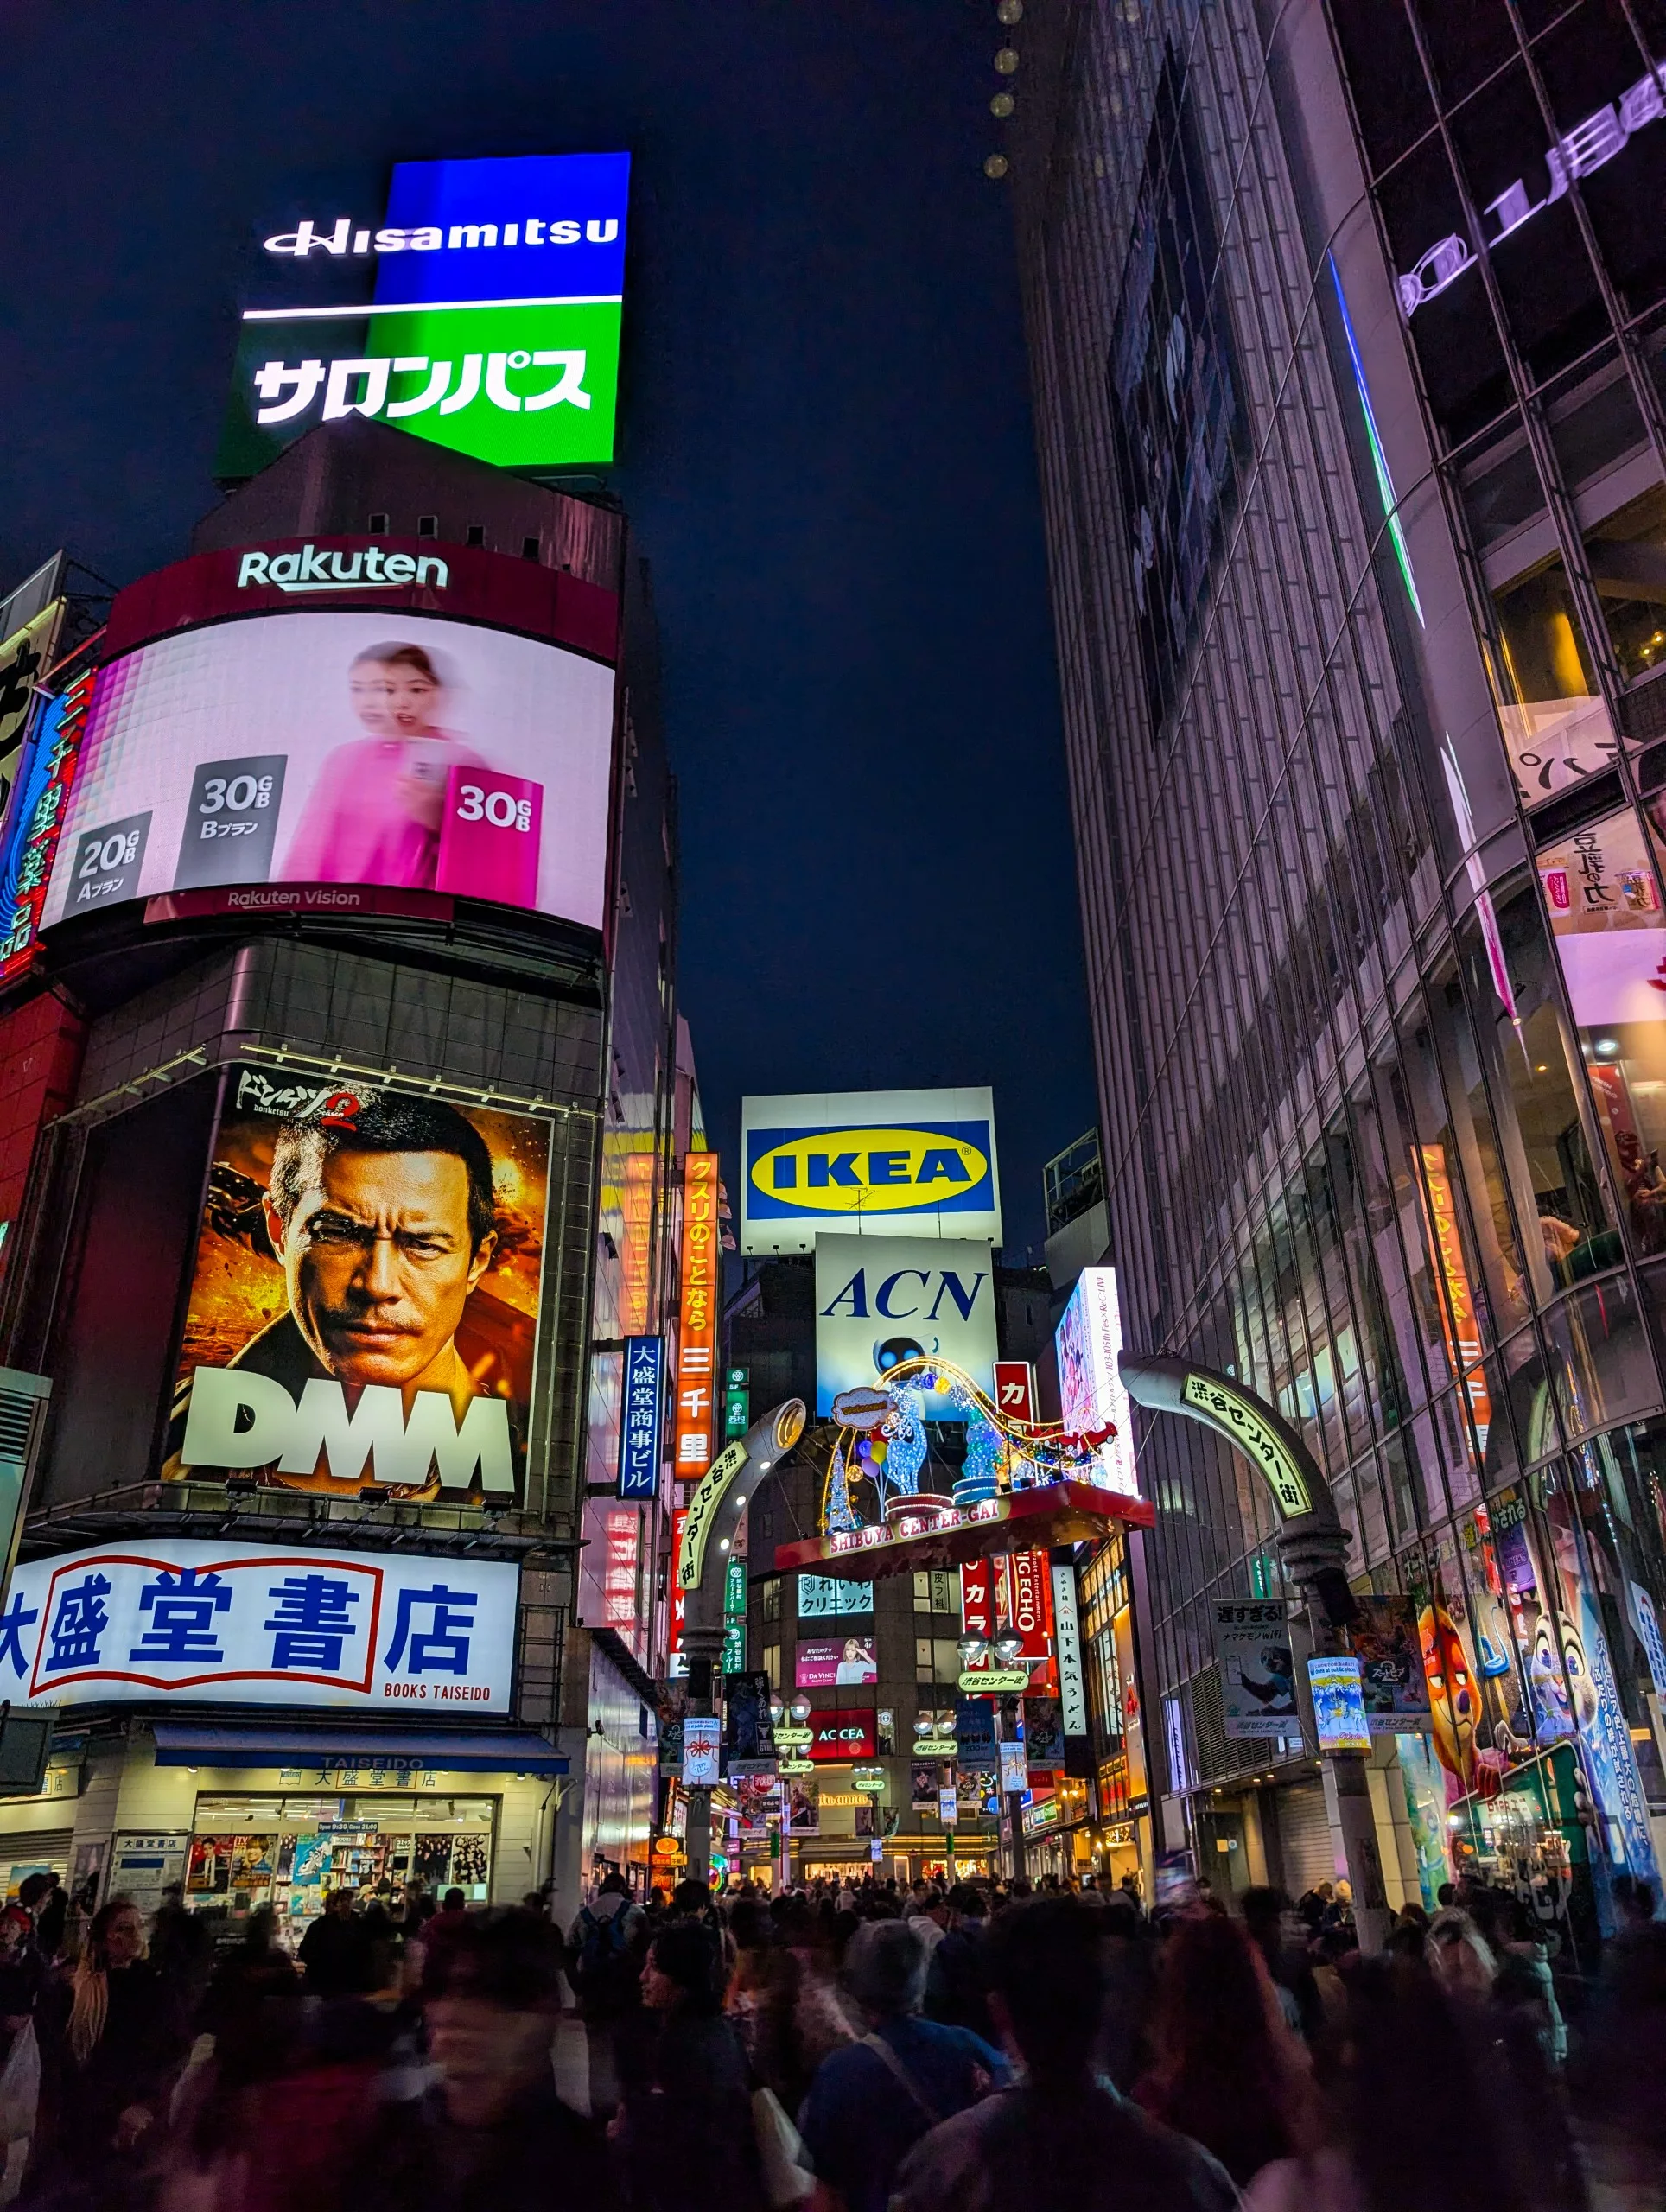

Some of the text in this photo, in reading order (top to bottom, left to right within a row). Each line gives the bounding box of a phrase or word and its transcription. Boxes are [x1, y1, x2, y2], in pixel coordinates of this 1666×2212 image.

[264, 219, 619, 257] Hisamitsu
[254, 350, 591, 424] サロンパス
[238, 544, 448, 595] Rakuten
[200, 820, 258, 840] Bプラン
[76, 877, 124, 903] Aプラン
[228, 889, 360, 909] Rakuten Vision
[320, 1093, 360, 1132] 2
[773, 1148, 973, 1190] IKEA
[678, 1161, 711, 1462] クスリのことなら 三千里
[818, 1268, 989, 1322] ACN
[181, 1366, 515, 1493] DMM
[626, 1345, 657, 1489] 大盛堂商事ビル
[1192, 1381, 1300, 1506] 渋谷センター街
[682, 1449, 738, 1586] 渋谷センター街
[830, 1499, 999, 1554] SHIBUYA CENTER-GAI
[802, 1594, 872, 1614] クリニック
[934, 1572, 945, 1609] 皮フ科
[1017, 1579, 1035, 1632] ECHO
[1033, 1574, 1042, 1622] Entertainment
[0, 1568, 478, 1680] 大盛堂書店
[384, 1682, 491, 1701] BOOKS TAISEIDO
[961, 1675, 1026, 1687] 渋谷センター街
[1060, 1620, 1082, 1730] 山下本気うどん
[321, 1756, 424, 1770] TAISEIDO
[915, 1744, 957, 1752] 渋谷センター街
[315, 1767, 438, 1788] 大盛堂書店
[124, 1838, 177, 1848] 大盛堂書店
[318, 1823, 332, 1832] Open
